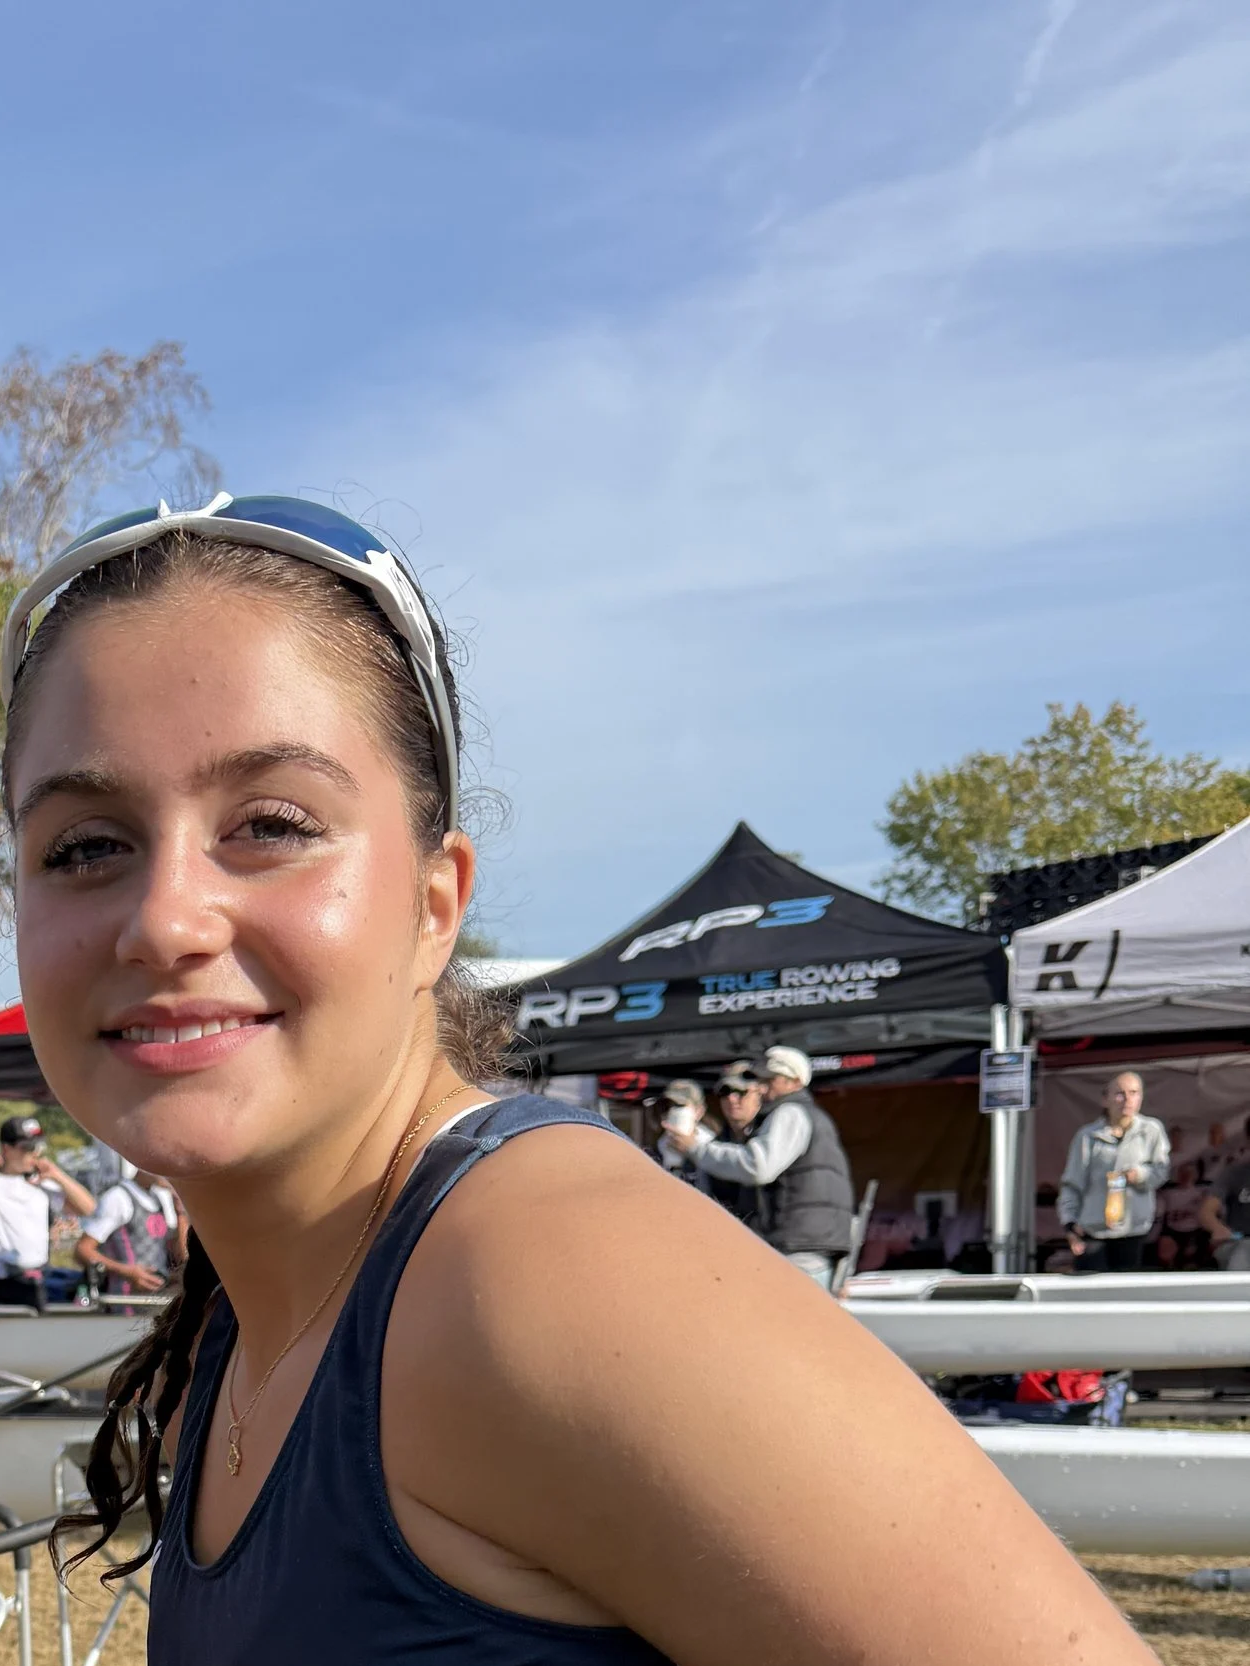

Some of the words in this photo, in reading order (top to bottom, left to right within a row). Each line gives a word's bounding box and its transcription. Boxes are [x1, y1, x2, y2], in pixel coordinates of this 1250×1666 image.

[618, 895, 835, 963] RP3
[698, 980, 880, 1016] EXPERIENCE
[699, 970, 778, 995] TRUE
[780, 957, 902, 988] ROWING
[516, 980, 668, 1030] RP3
